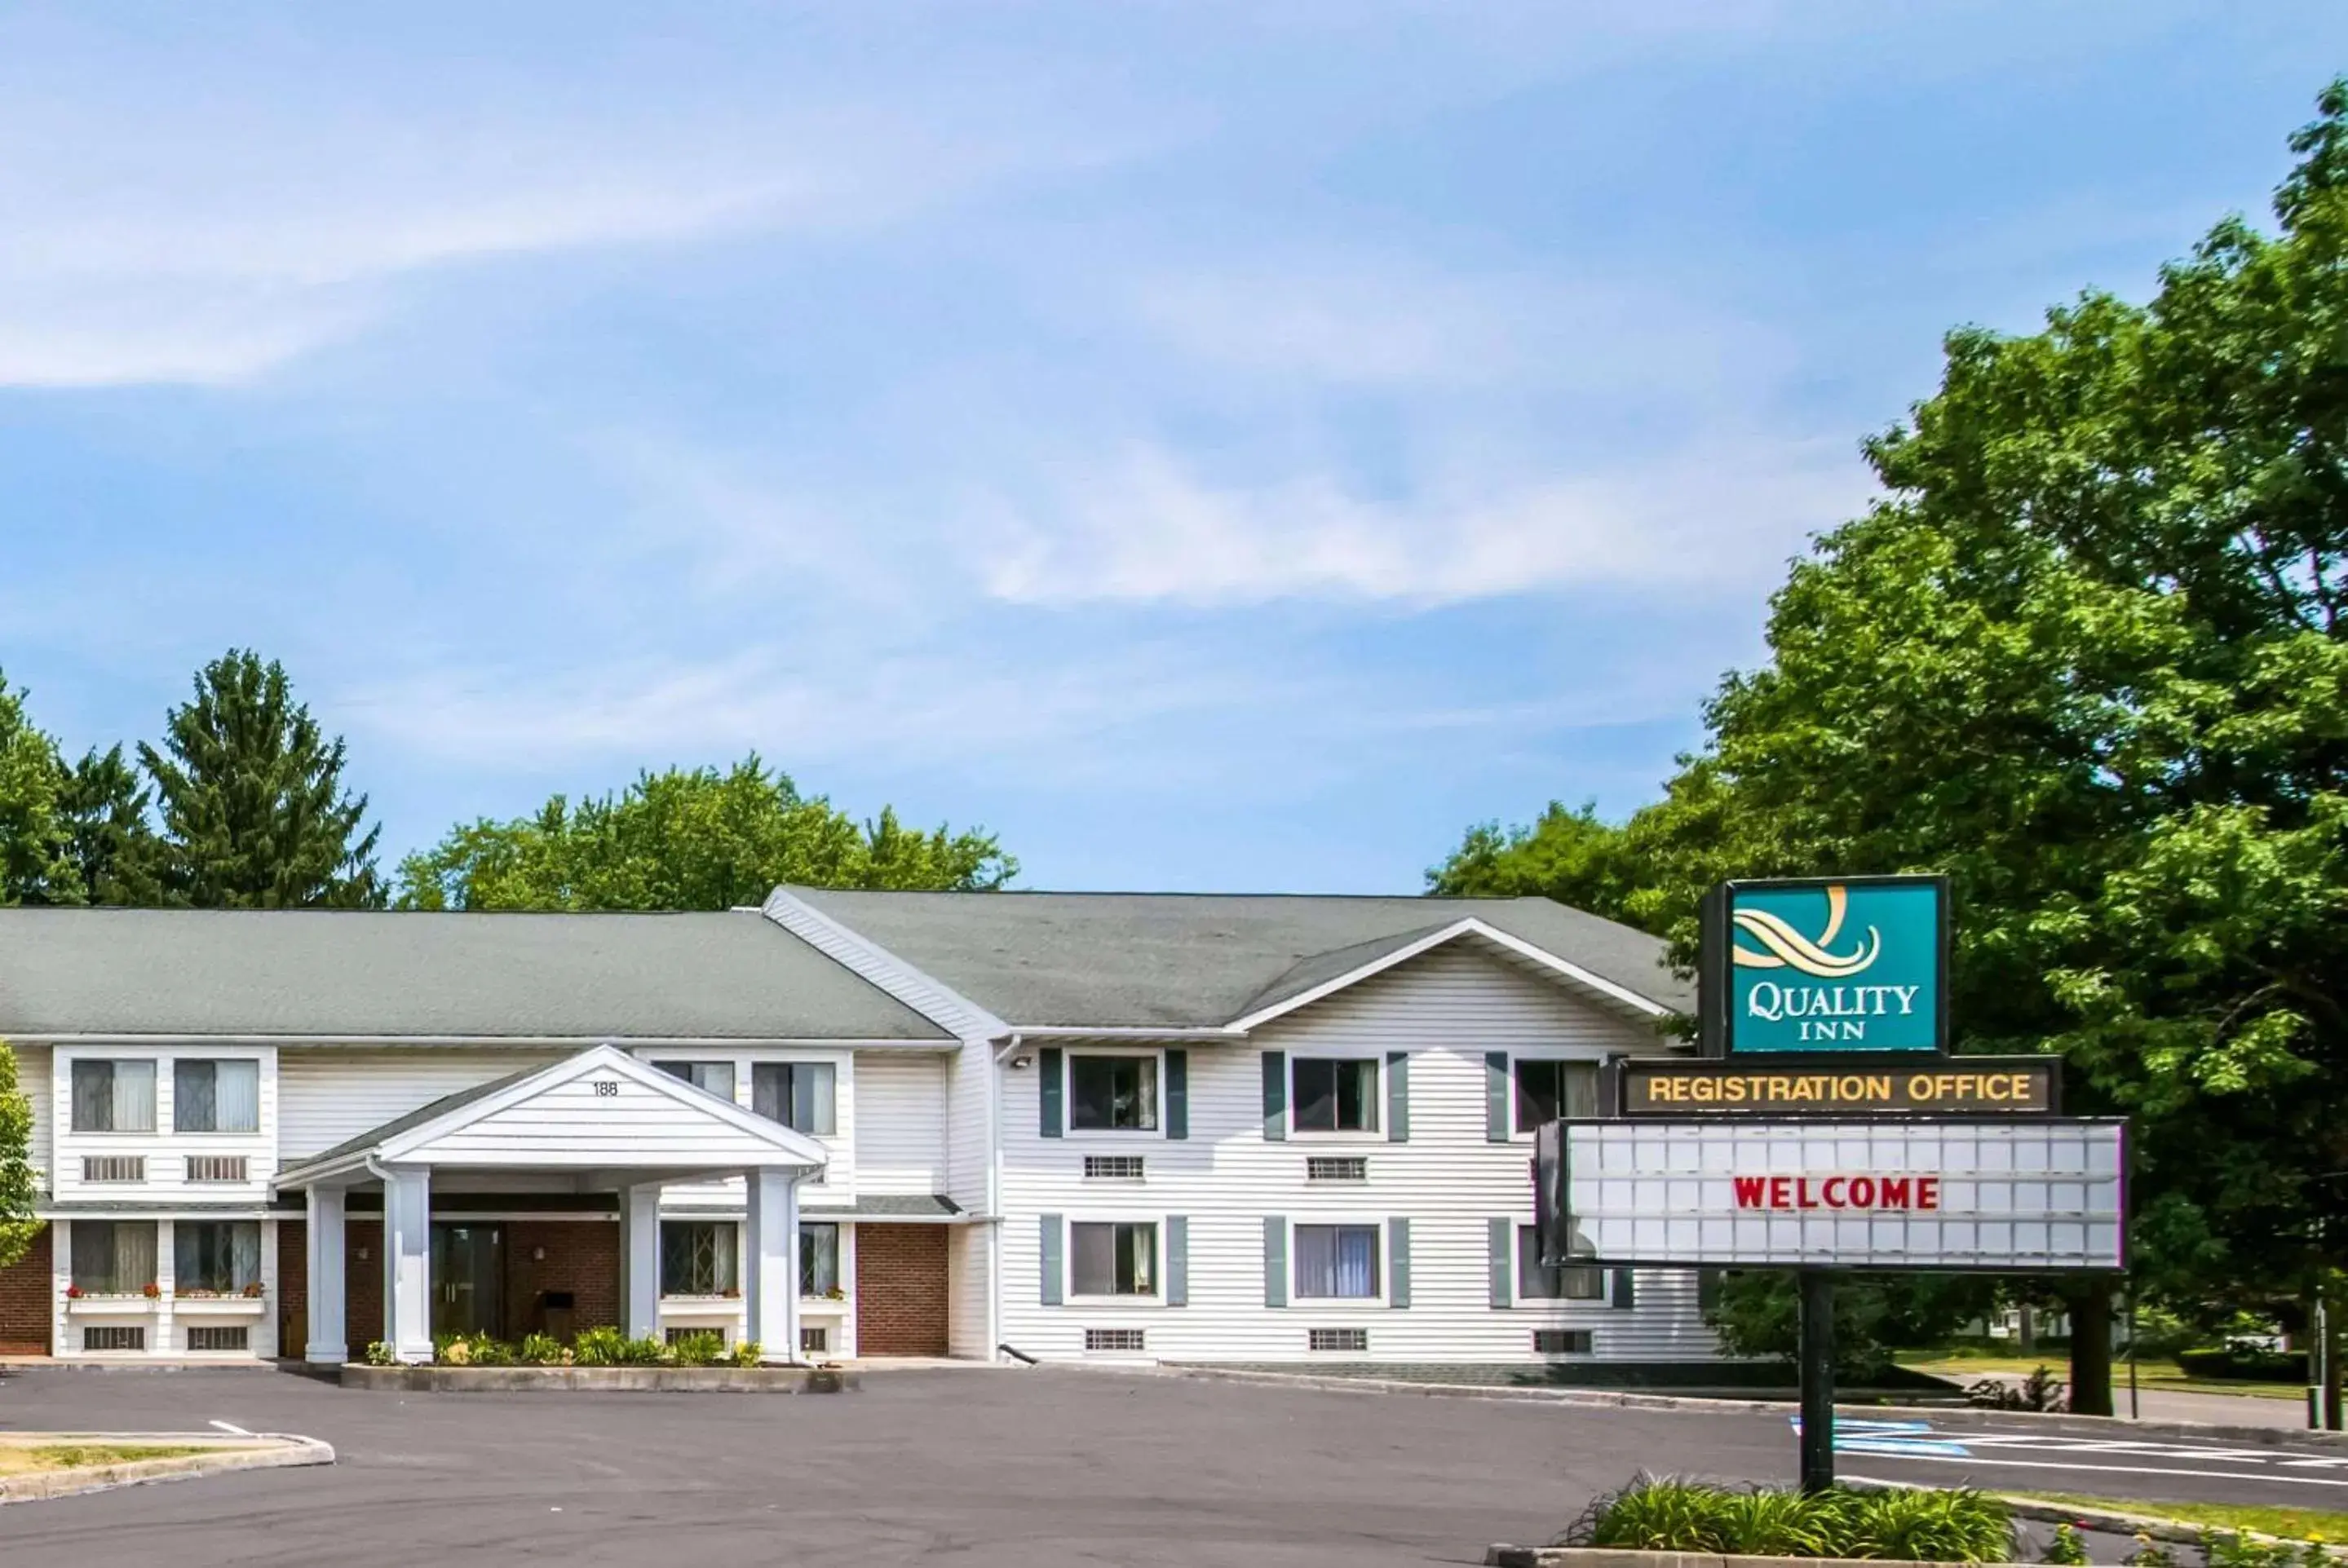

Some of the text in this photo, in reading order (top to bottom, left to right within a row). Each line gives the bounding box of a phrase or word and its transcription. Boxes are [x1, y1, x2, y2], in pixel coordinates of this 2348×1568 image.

[1748, 982, 1920, 1022] QUALITY
[1799, 1020, 1865, 1041] INN
[594, 1081, 618, 1097] 188
[1648, 1074, 2031, 1102] REGISTRATION OFFICE
[1734, 1177, 1939, 1209] WELCOME
